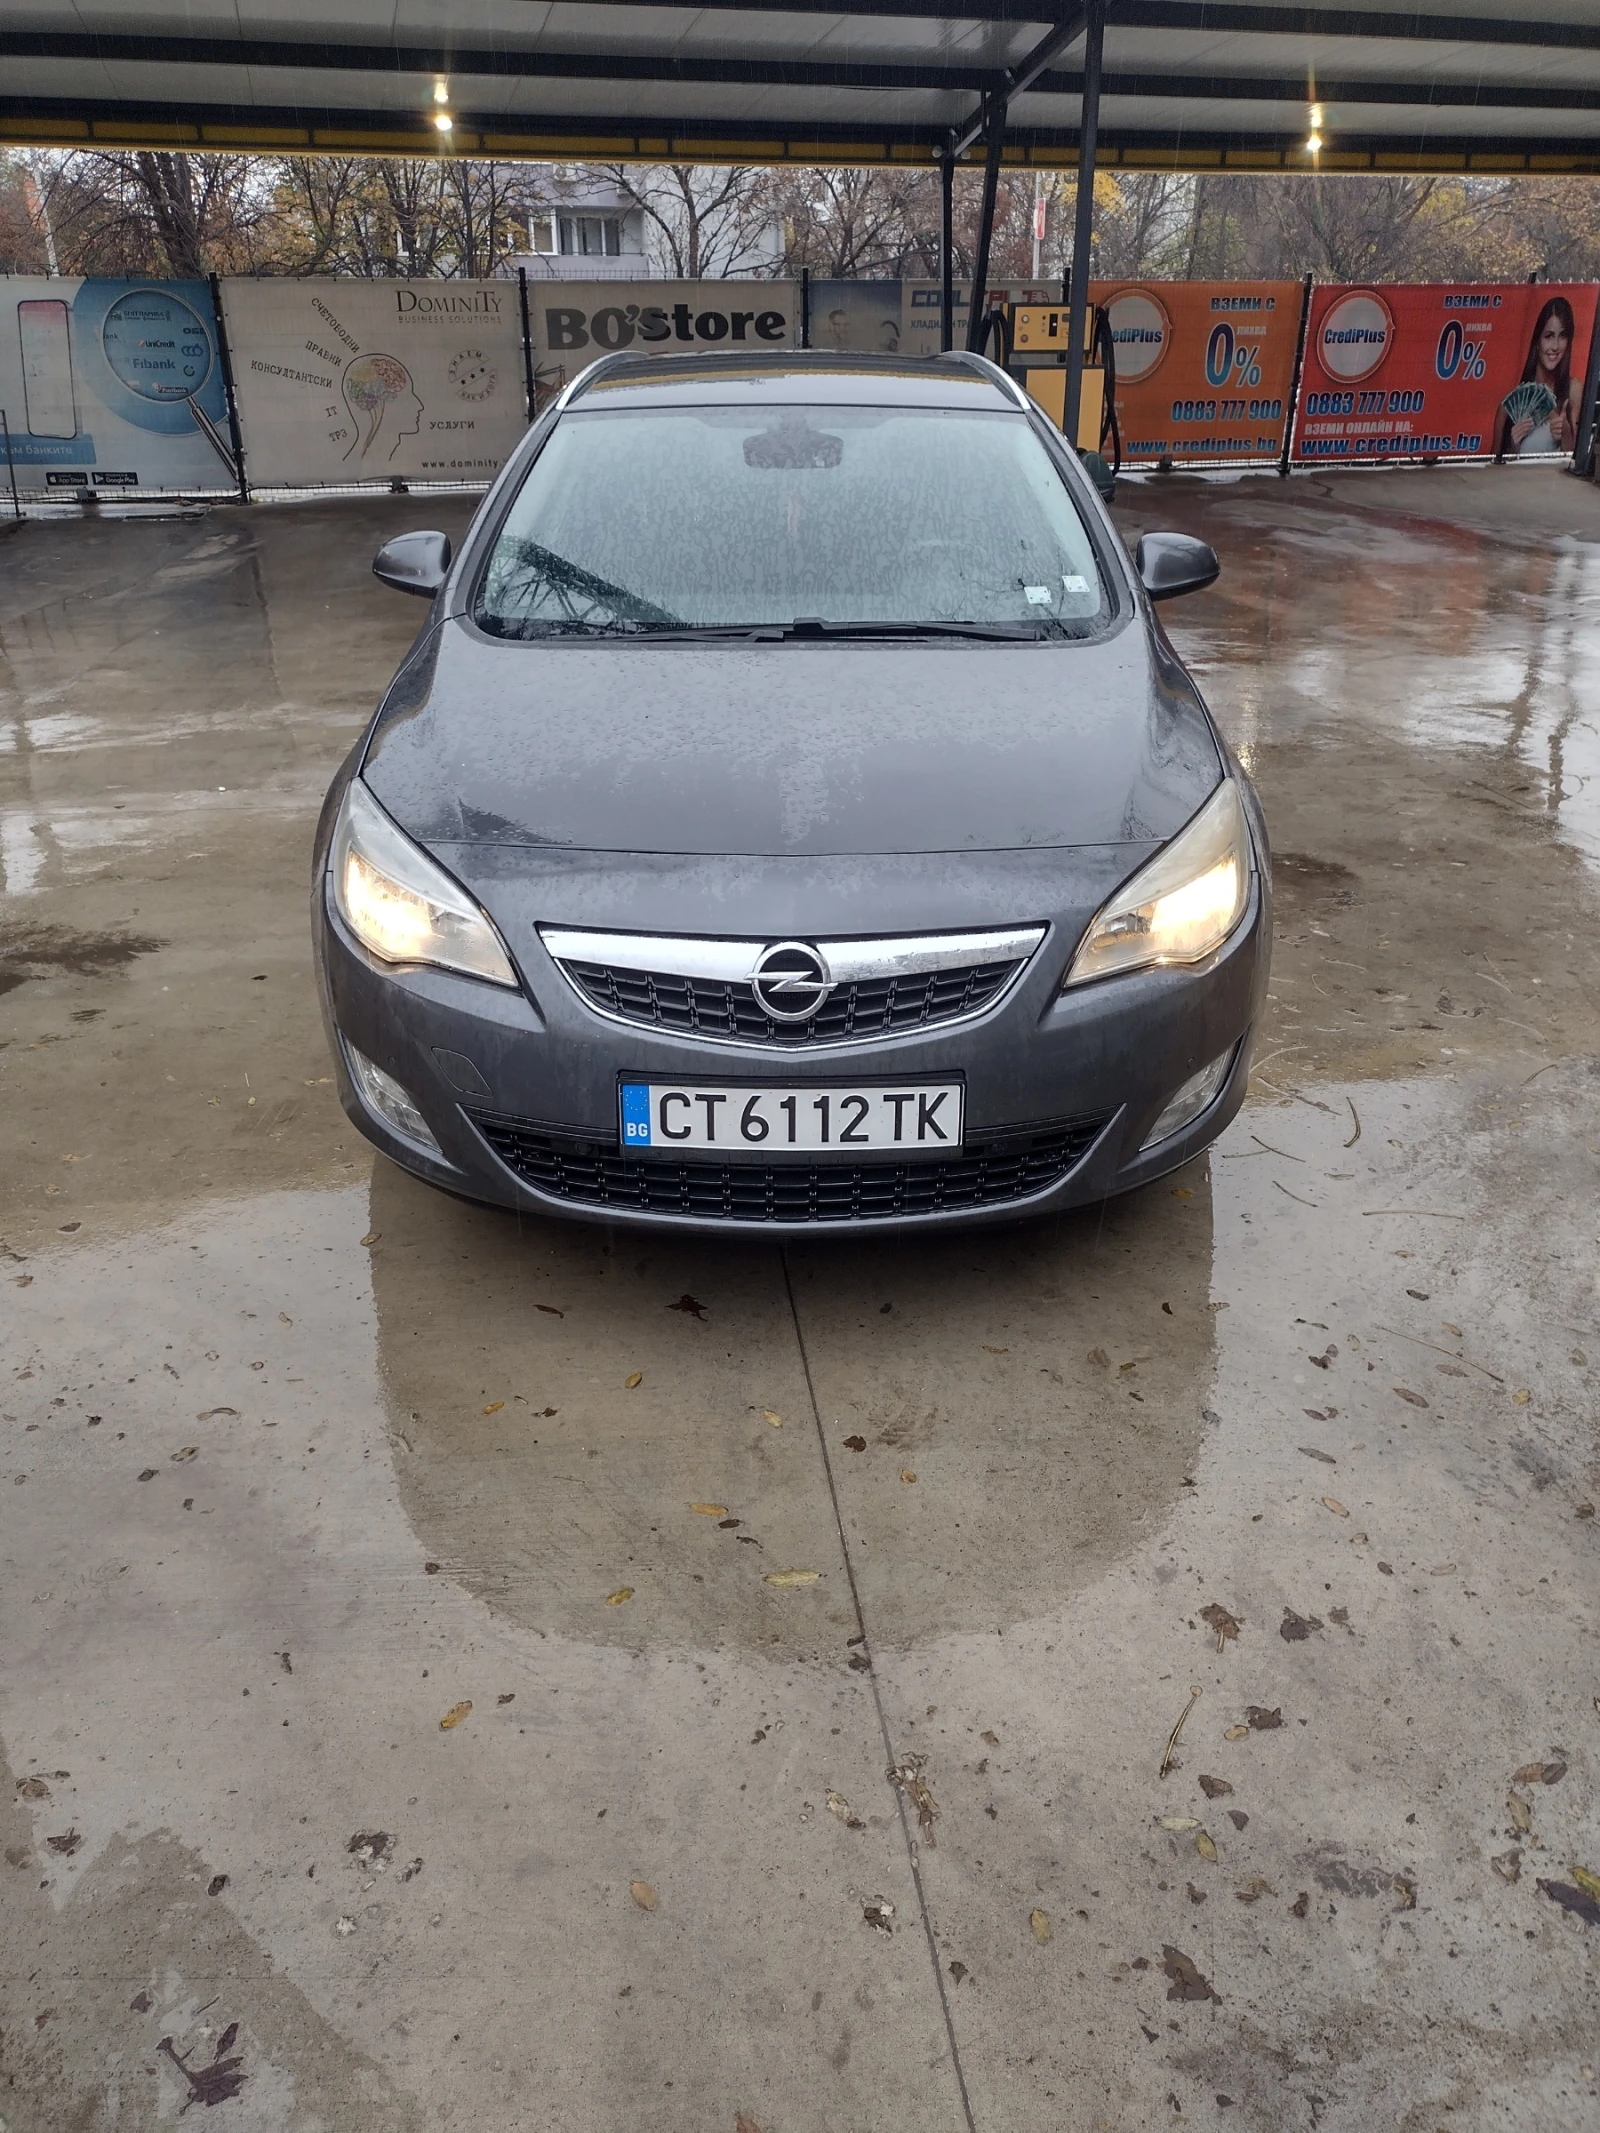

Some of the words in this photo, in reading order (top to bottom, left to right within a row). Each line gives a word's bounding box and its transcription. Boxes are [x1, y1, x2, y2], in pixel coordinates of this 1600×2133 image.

[1210, 297, 1262, 311] ВЗЕМИ
[1444, 295, 1490, 308] ВЗЕМИ
[311, 297, 360, 354] СЧЕТОВОДНИ
[398, 315, 444, 324] BUSINESS
[449, 315, 502, 324] SOLUTIONS
[1111, 328, 1163, 343] ediPlus
[1324, 328, 1386, 344] CrediPlus
[146, 340, 175, 348] UniCredit
[305, 340, 342, 367] ПРАВНИ
[132, 358, 176, 369] Fibank
[250, 360, 333, 388] КОНСУЛТАНТСКИ
[1171, 400, 1216, 421] 0883
[1220, 399, 1246, 420] 777
[1250, 399, 1282, 420] 900
[1306, 391, 1354, 416] 0883
[1357, 390, 1386, 414] 777
[1388, 389, 1425, 413] 900
[429, 420, 475, 430] УСЛУГИ
[1304, 423, 1344, 435] ВЗЕМИ
[1346, 420, 1393, 434] ОНЛАЙН
[1395, 421, 1413, 433] НА:
[26, 444, 73, 455] банките
[1126, 437, 1277, 454] www.crediplus.bg
[1301, 433, 1482, 455] www.crediplus.bg
[660, 1092, 727, 1141] CT
[740, 1095, 870, 1143] 6112
[883, 1092, 949, 1141] TK
[626, 1123, 648, 1138] BG
